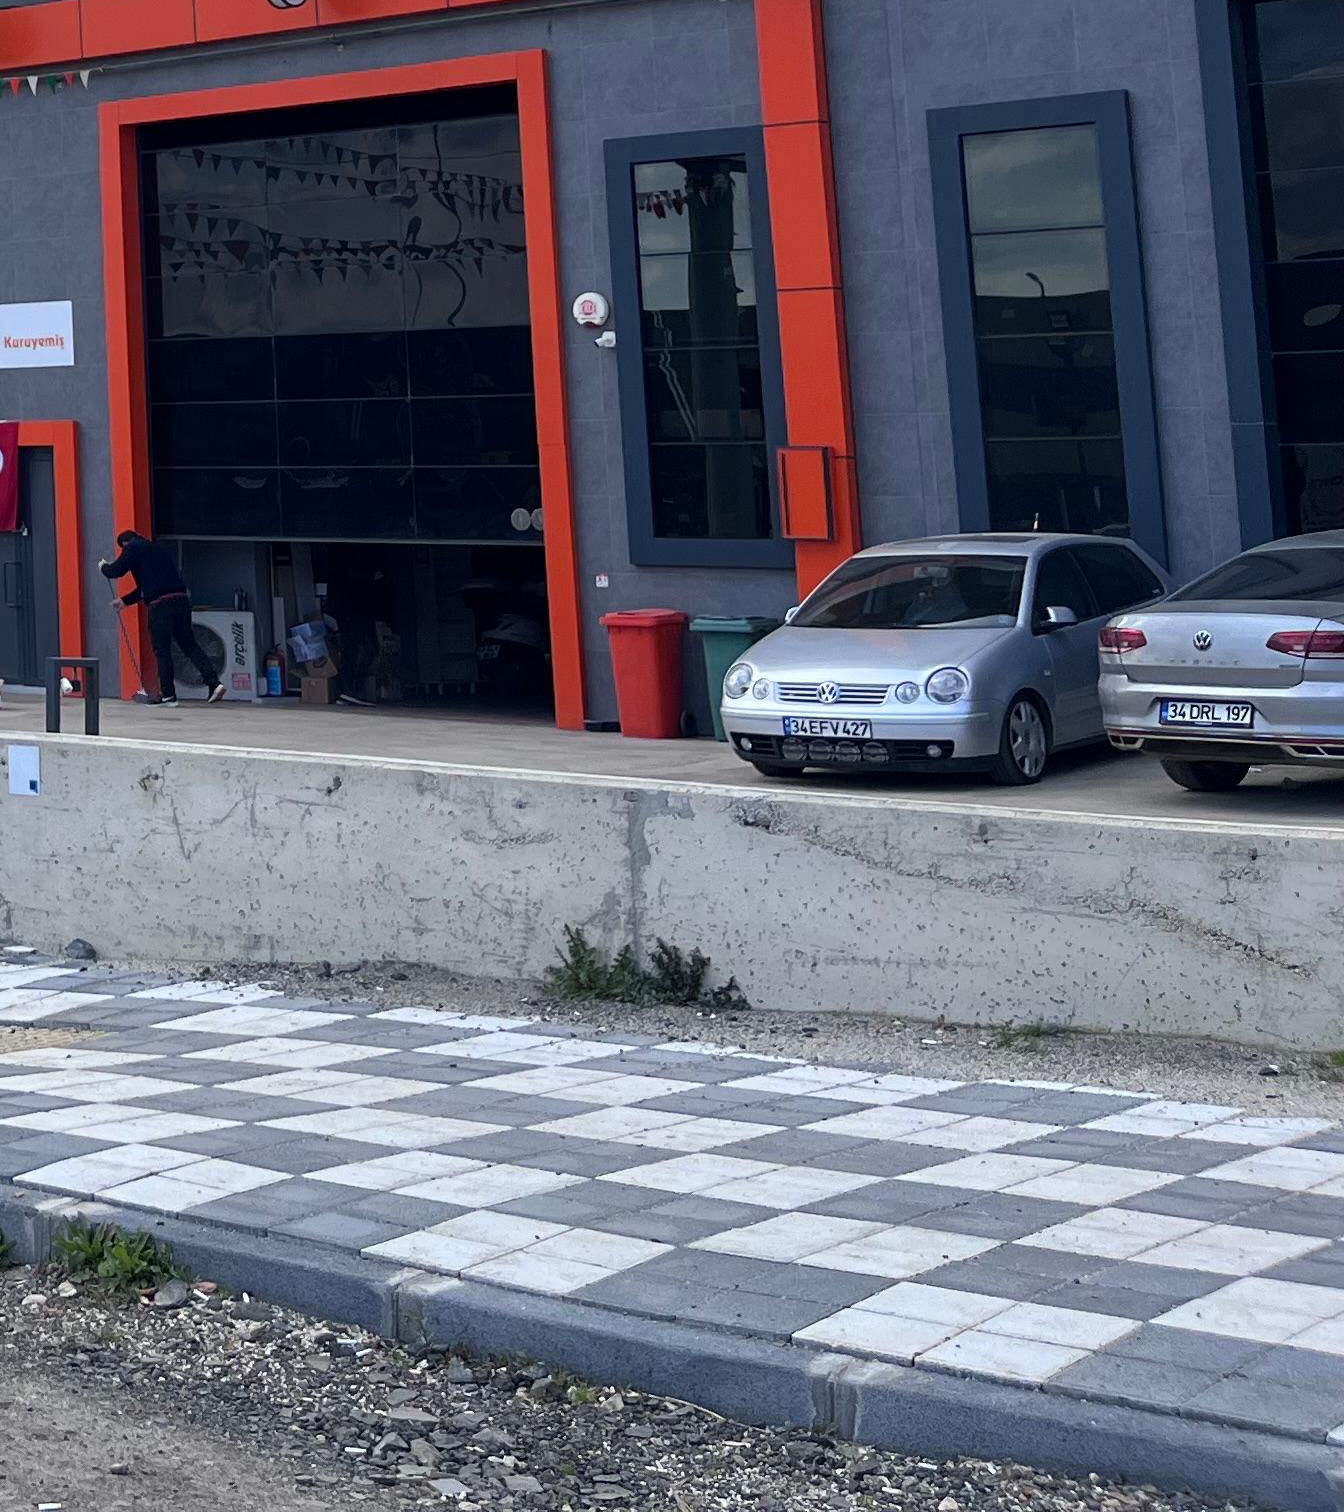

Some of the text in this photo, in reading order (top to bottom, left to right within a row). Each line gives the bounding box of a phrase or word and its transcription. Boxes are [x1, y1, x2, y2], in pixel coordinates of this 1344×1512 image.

[4, 334, 65, 350] Kuruyemiş
[232, 621, 248, 667] arçelik
[1169, 703, 1251, 722] 34 DRL 197
